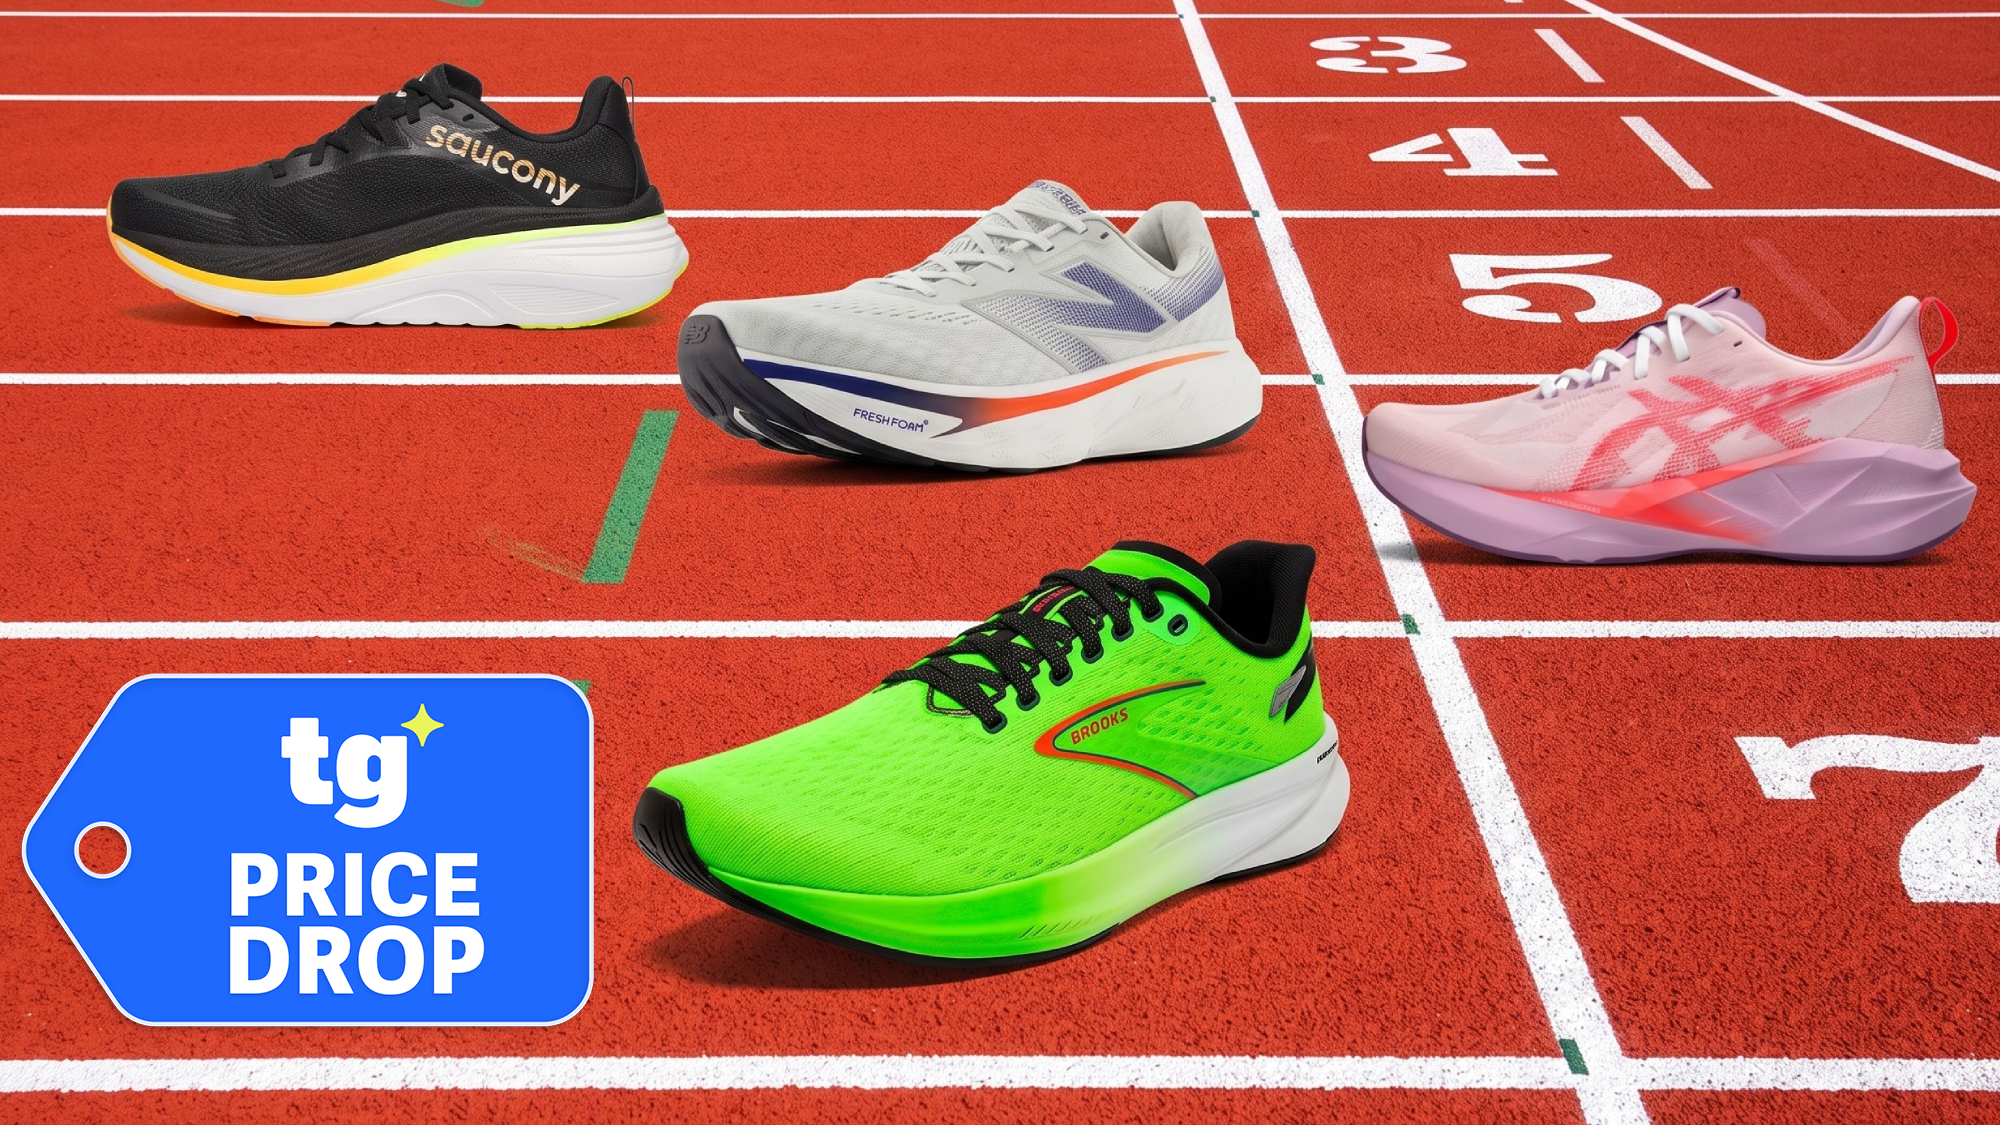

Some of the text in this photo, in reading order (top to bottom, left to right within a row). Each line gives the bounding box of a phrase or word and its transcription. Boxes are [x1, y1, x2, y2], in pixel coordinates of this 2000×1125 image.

[1309, 36, 1468, 74] 3
[425, 124, 581, 206] saucony
[1368, 127, 1559, 177] 4
[1448, 253, 1663, 324] 5
[853, 407, 891, 426] FRESH
[1070, 706, 1130, 746] BROOKS
[1733, 733, 2000, 904] 7
